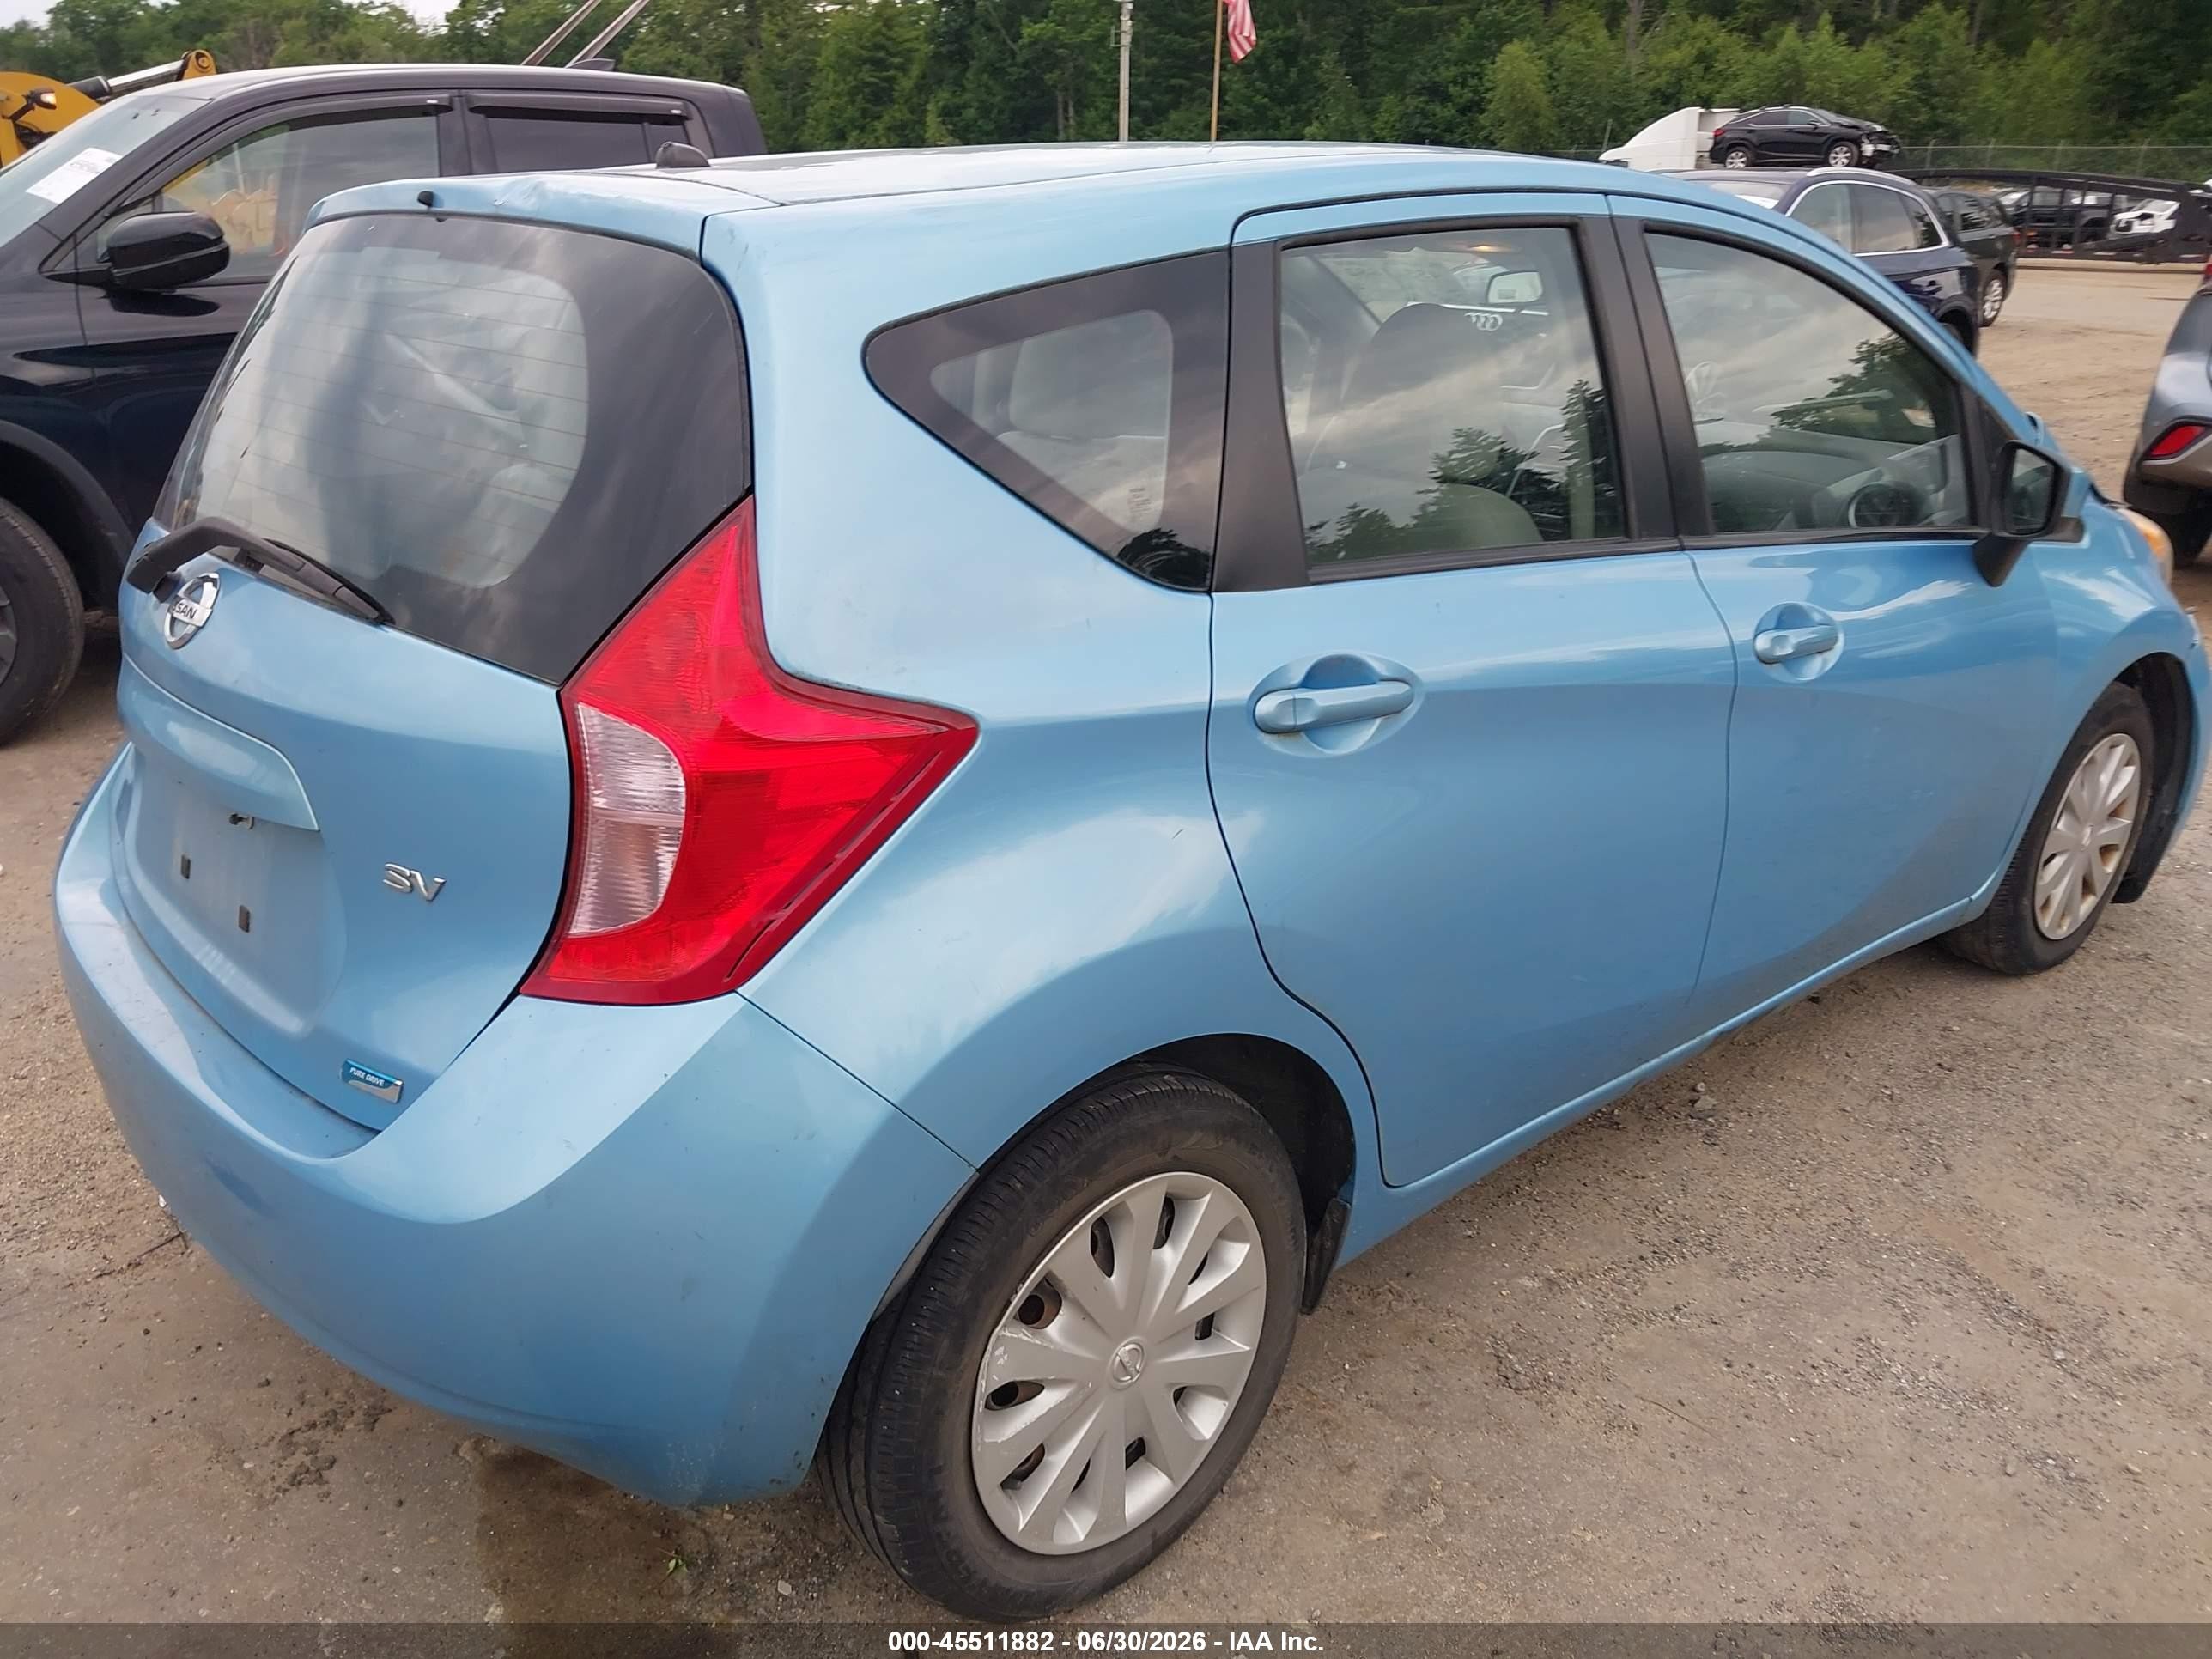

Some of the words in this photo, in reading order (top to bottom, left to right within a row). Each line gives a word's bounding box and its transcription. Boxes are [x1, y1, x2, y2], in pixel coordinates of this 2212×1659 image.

[383, 863, 447, 901] SV
[349, 1067, 366, 1079] PURE
[366, 1074, 385, 1086] DRIVE
